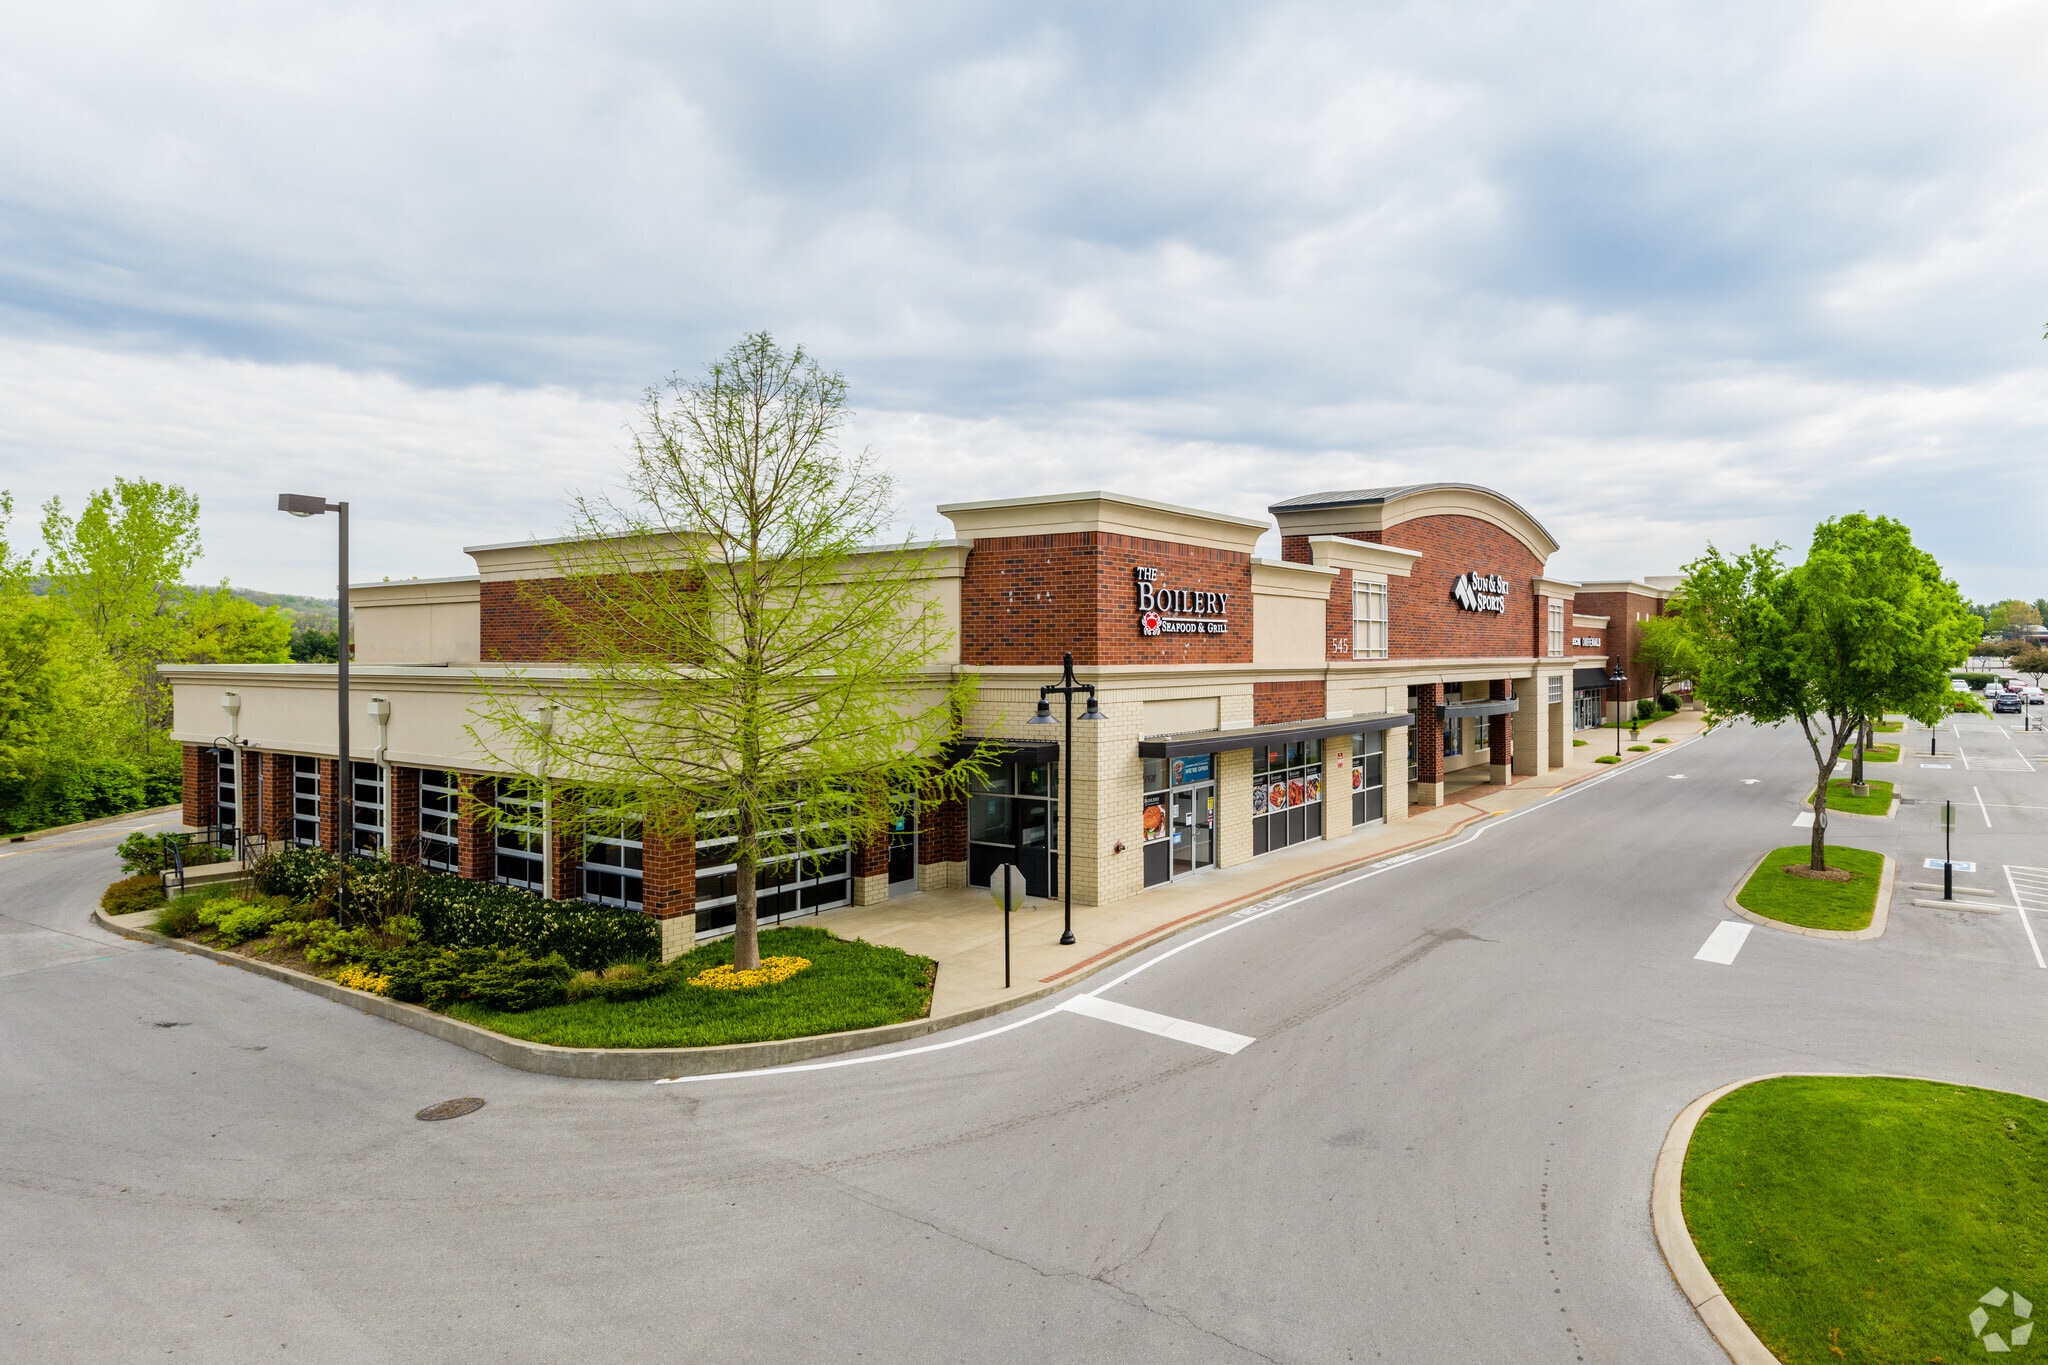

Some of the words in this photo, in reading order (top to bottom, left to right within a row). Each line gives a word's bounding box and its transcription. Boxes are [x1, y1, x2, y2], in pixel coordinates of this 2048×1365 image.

[1137, 566, 1158, 581] THE
[1472, 571, 1488, 592] SUN
[1489, 574, 1496, 593] &
[1496, 575, 1509, 594] SKI
[1137, 581, 1229, 614] BOILERY
[1477, 593, 1505, 614] SPORTS
[1161, 620, 1196, 633] SEAFOOD
[1197, 622, 1206, 633] &
[1207, 622, 1228, 633] GRILL
[1332, 638, 1349, 653] 545
[1229, 906, 1265, 919] FIRE
